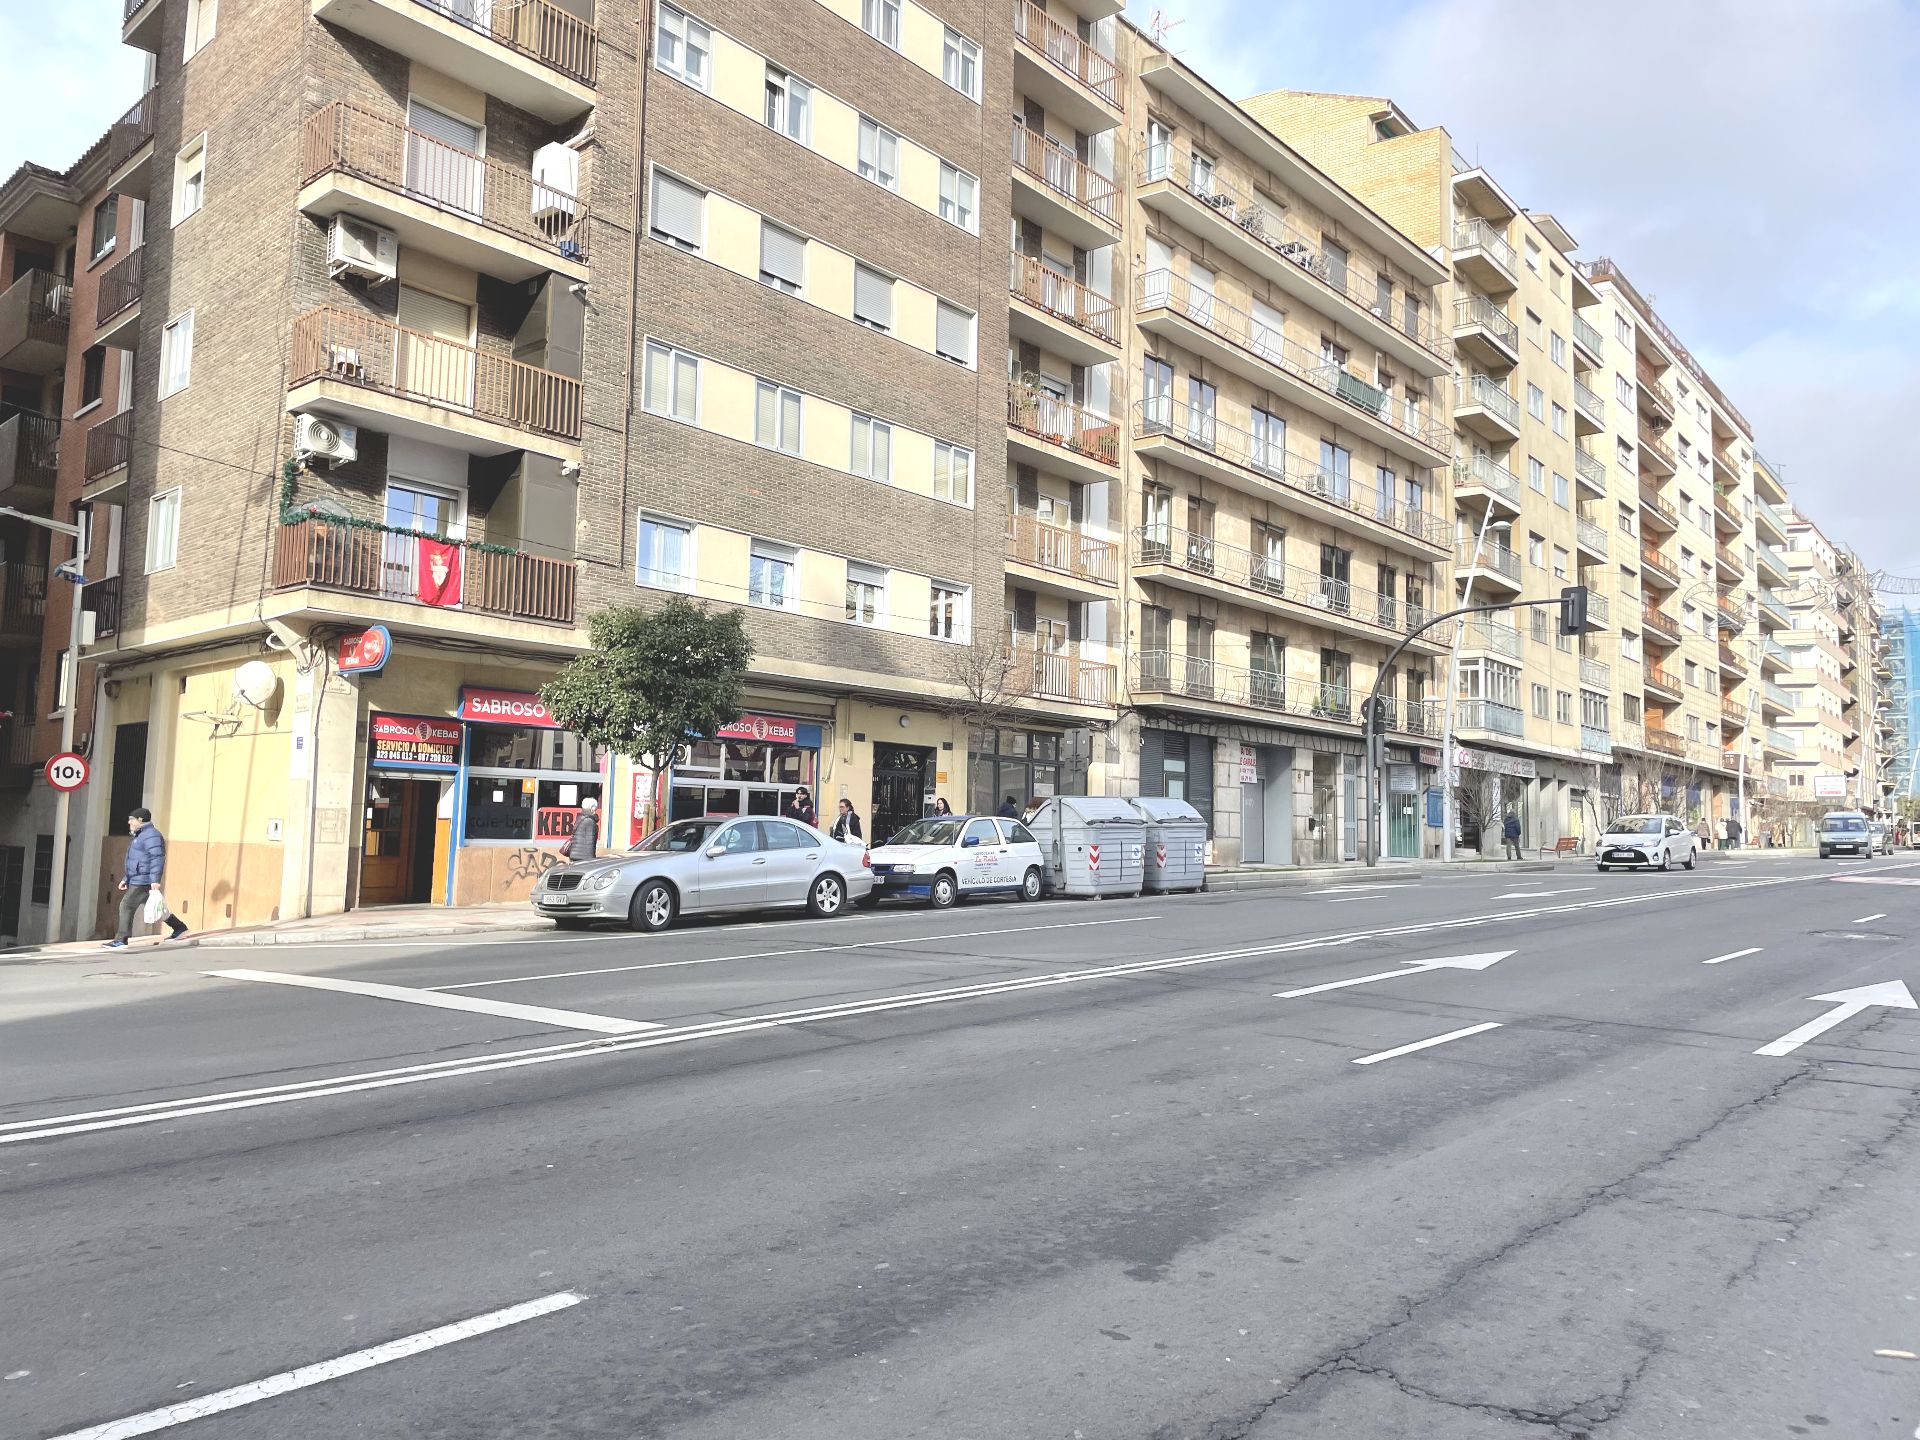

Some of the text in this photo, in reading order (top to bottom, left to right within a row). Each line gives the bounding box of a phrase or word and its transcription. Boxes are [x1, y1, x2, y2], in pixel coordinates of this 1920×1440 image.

[472, 697, 546, 718] SABROSO
[373, 724, 459, 739] SABROSO KEBAB
[768, 726, 794, 737] KEBAB
[376, 740, 410, 752] SERVICIO
[411, 742, 416, 753] A
